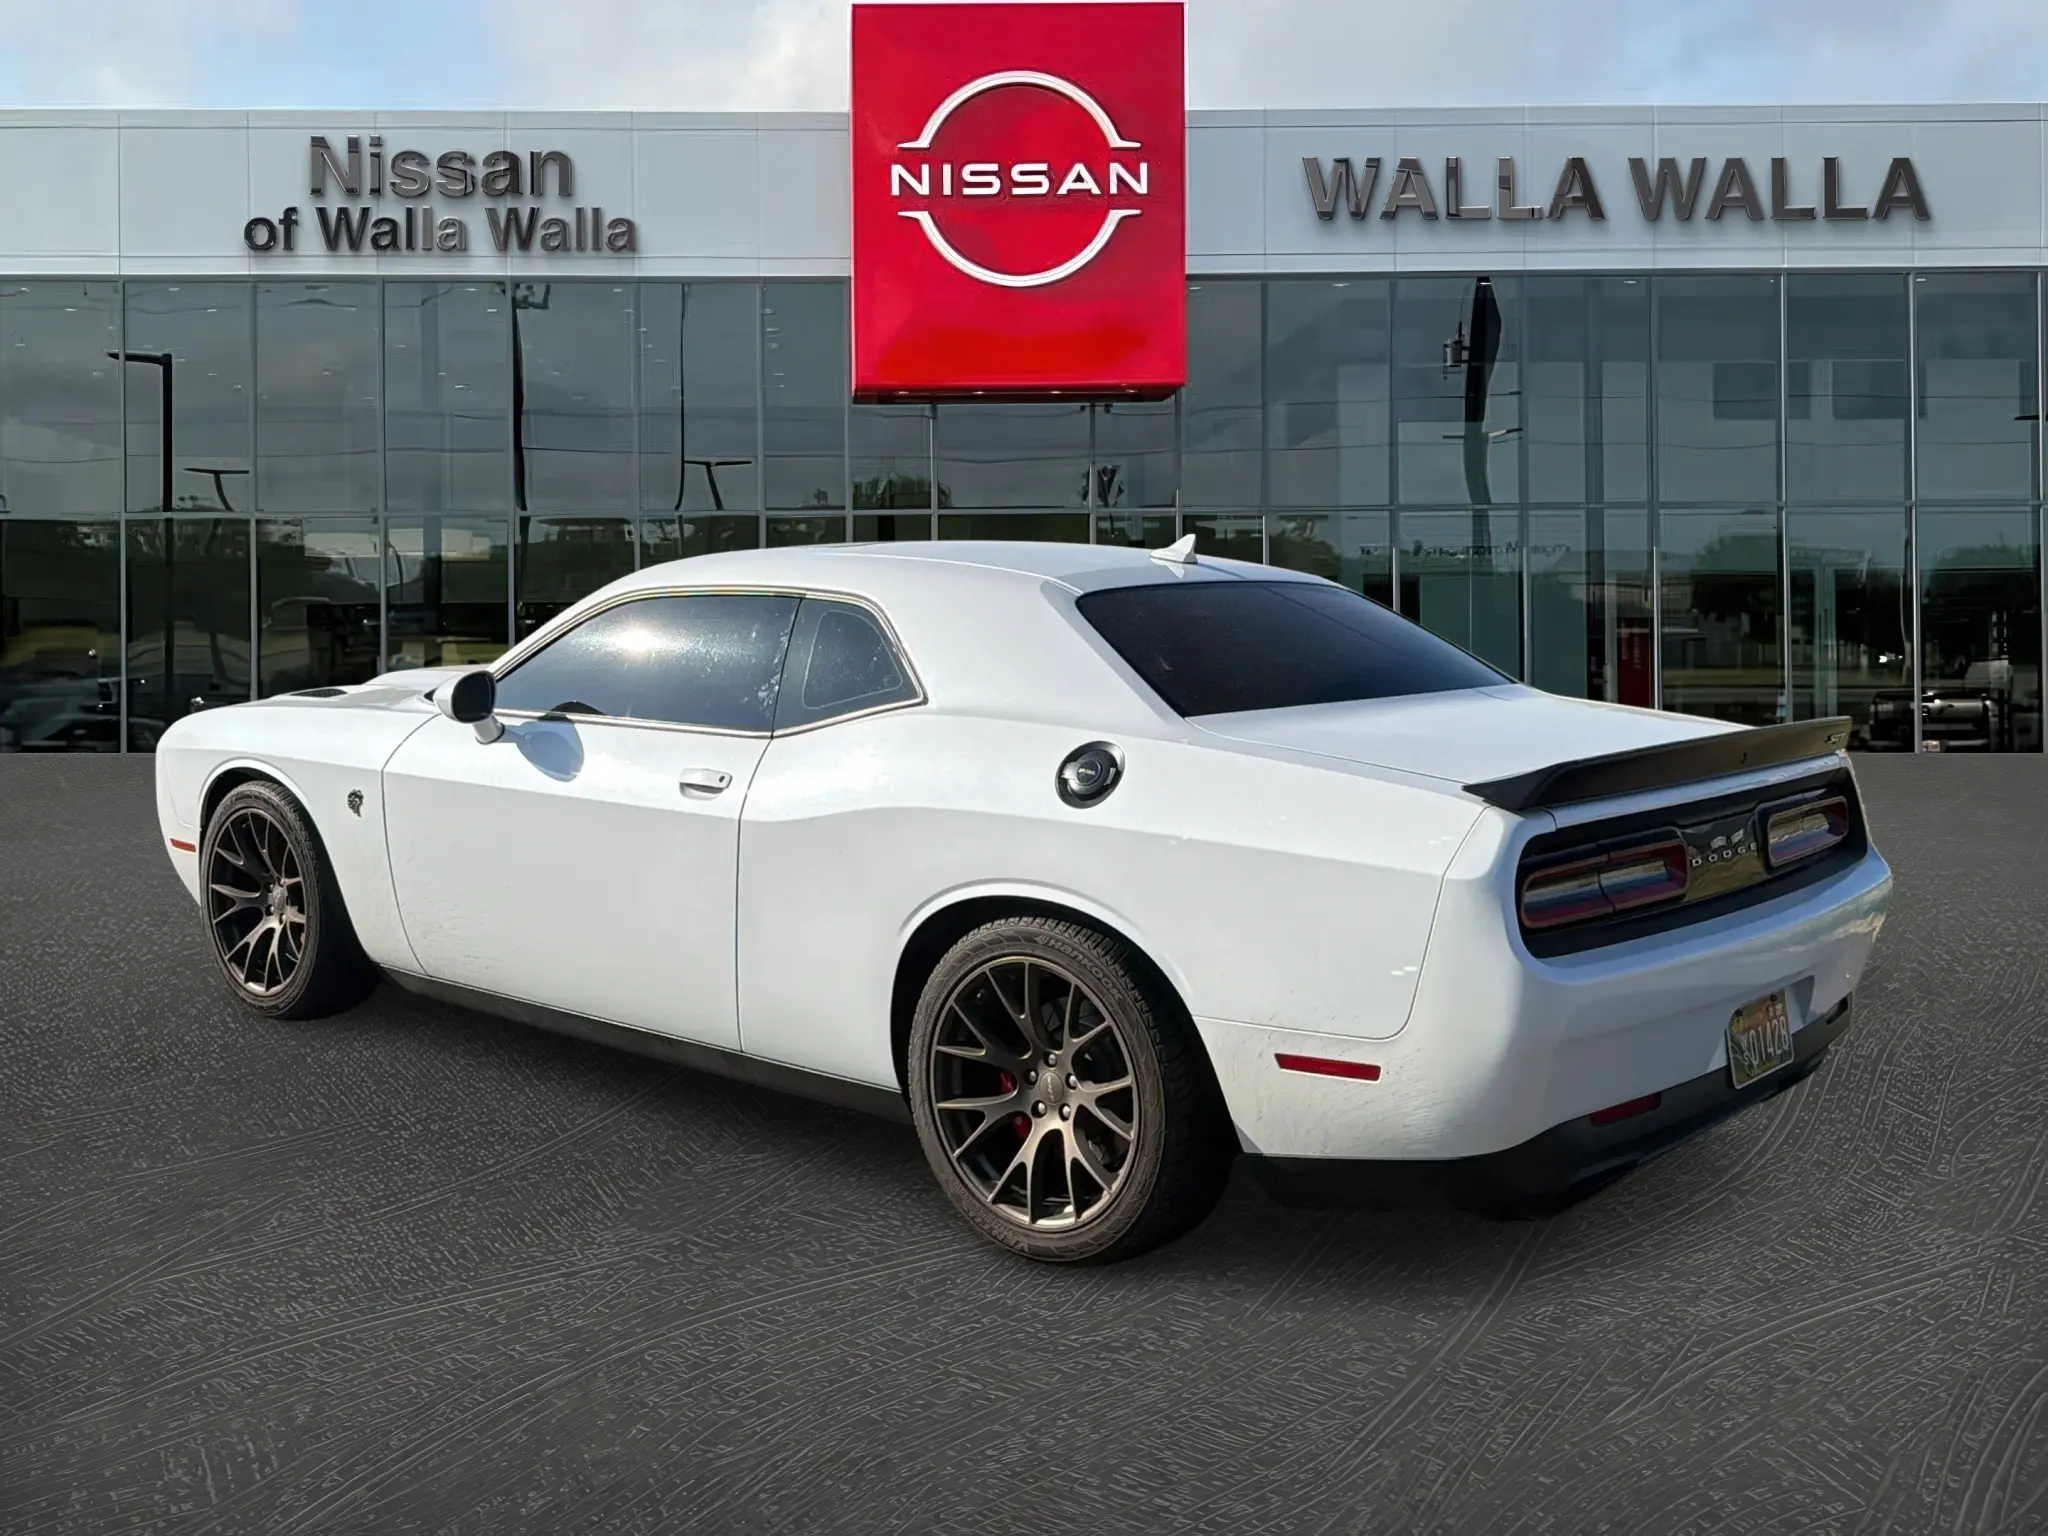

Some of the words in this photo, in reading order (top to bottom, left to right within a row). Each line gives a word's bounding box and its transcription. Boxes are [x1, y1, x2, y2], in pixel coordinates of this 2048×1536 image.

[309, 133, 573, 198] Nissan
[890, 161, 1148, 196] NISSAN
[1301, 156, 1605, 221] WALLA
[1627, 156, 1931, 221] WALLA
[243, 205, 299, 252] of
[314, 205, 468, 252] Walla
[484, 205, 637, 253] Walla
[1691, 842, 1758, 868] DODGE
